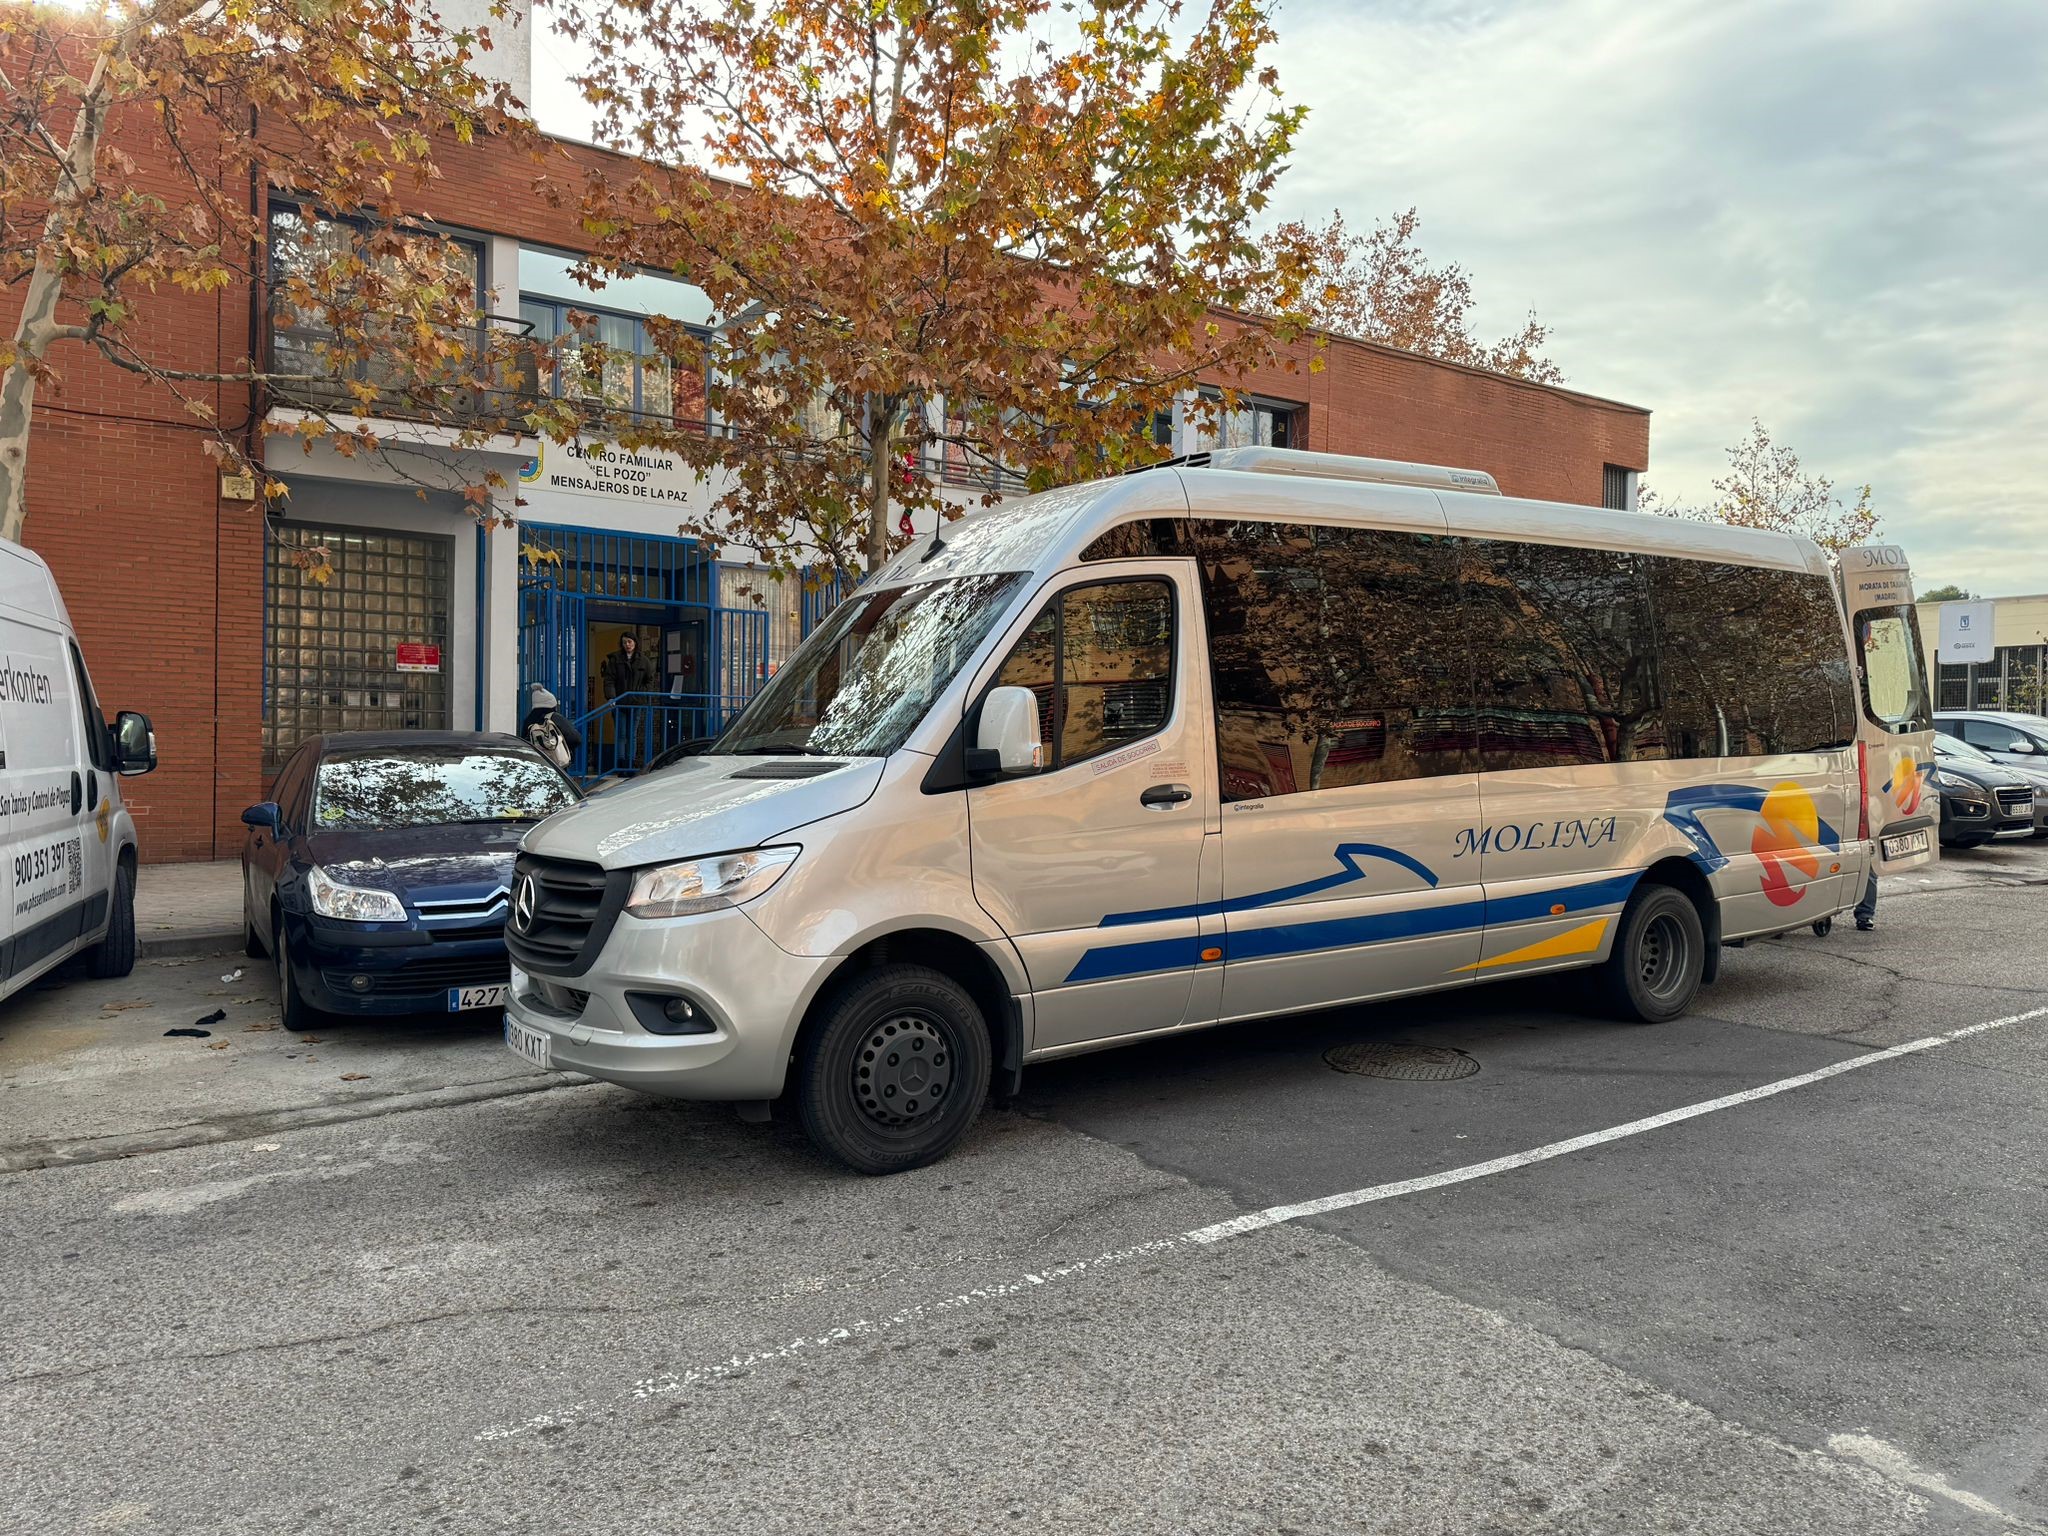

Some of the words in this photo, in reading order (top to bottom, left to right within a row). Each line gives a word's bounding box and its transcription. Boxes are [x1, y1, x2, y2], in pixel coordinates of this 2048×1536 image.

[567, 446, 616, 463] CENRO
[620, 453, 673, 471] FAMILIAR
[551, 475, 629, 495] MENSAJEROS
[633, 486, 647, 497] DE
[651, 488, 664, 500] LA
[667, 490, 688, 502] PAZ
[1859, 582, 1882, 591] MORATA
[32, 787, 49, 810] Control
[1453, 816, 1617, 858] MOLINA
[1889, 836, 1909, 854] 0380
[15, 853, 32, 887] 900
[34, 847, 49, 879] 351
[51, 842, 65, 872] 397
[461, 986, 509, 1007] 427
[525, 1031, 542, 1061] KXT
